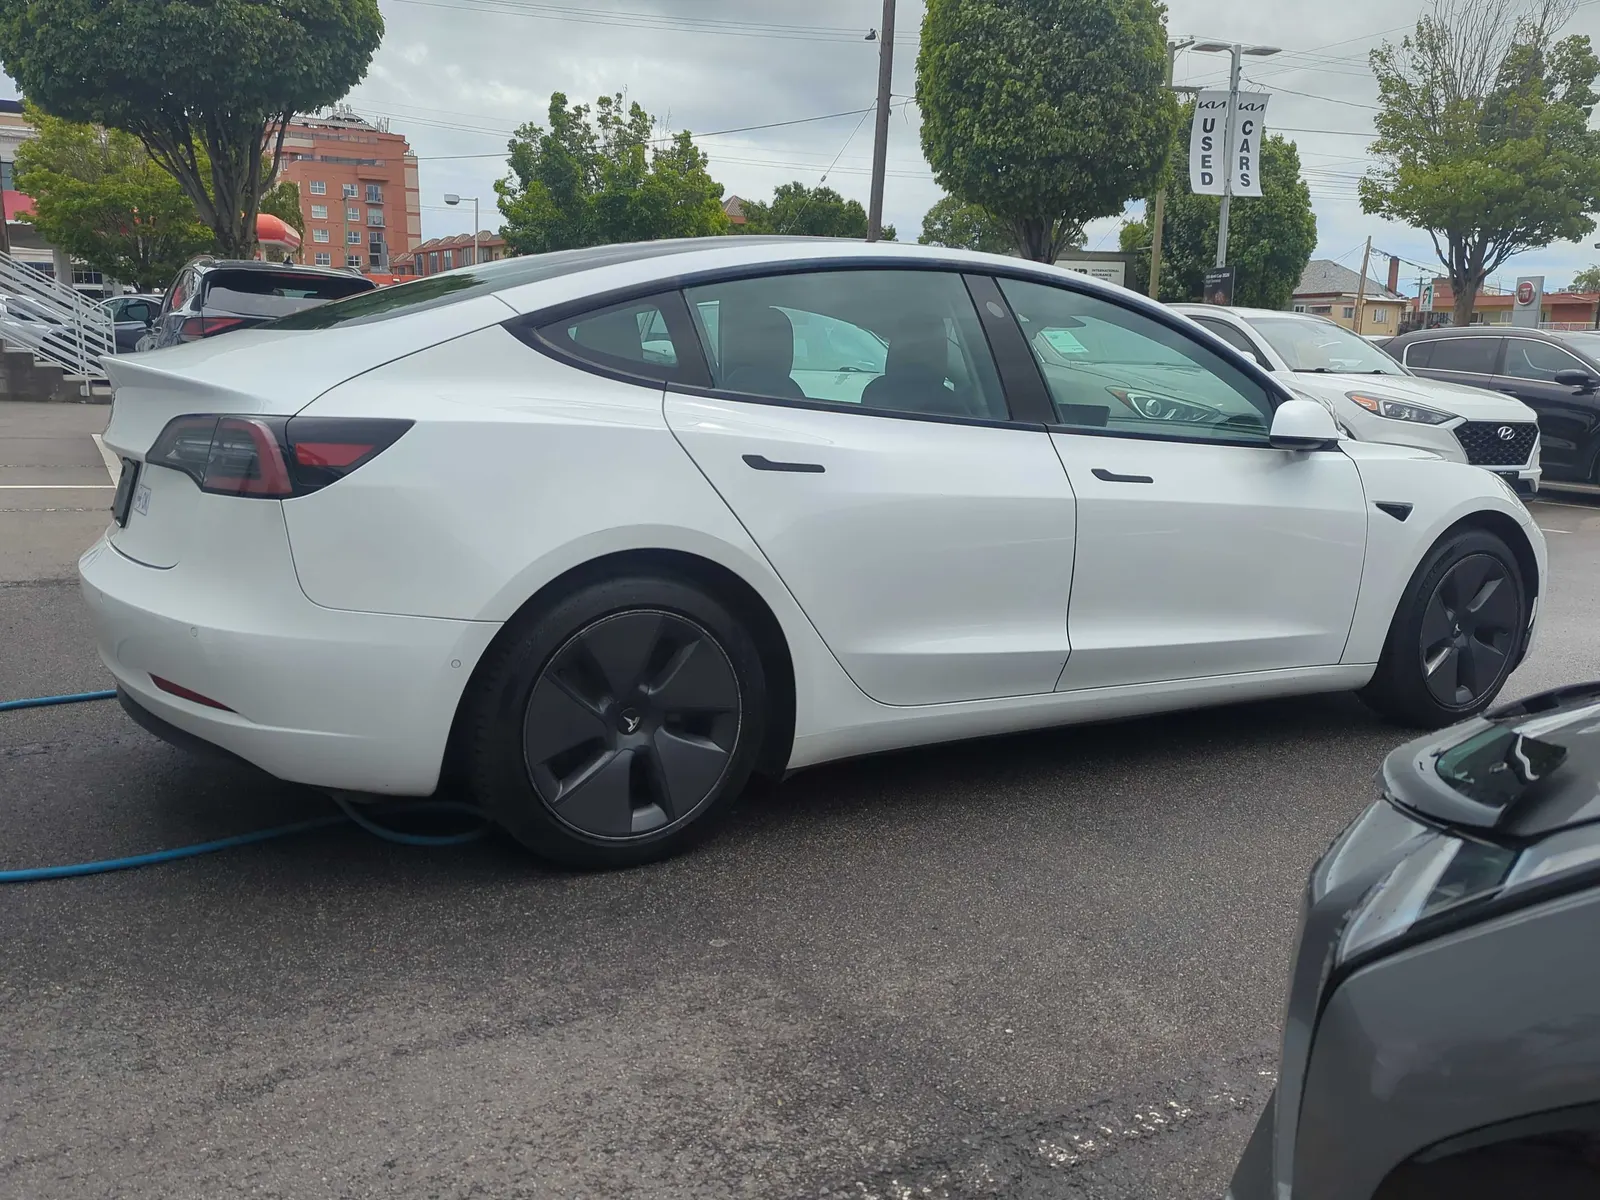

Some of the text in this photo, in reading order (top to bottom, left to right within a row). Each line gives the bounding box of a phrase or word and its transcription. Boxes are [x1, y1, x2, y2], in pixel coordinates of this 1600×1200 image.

[1198, 101, 1227, 109] KIA
[1238, 103, 1265, 111] KIA
[1200, 118, 1215, 186] USED
[1239, 120, 1254, 187] CARS
